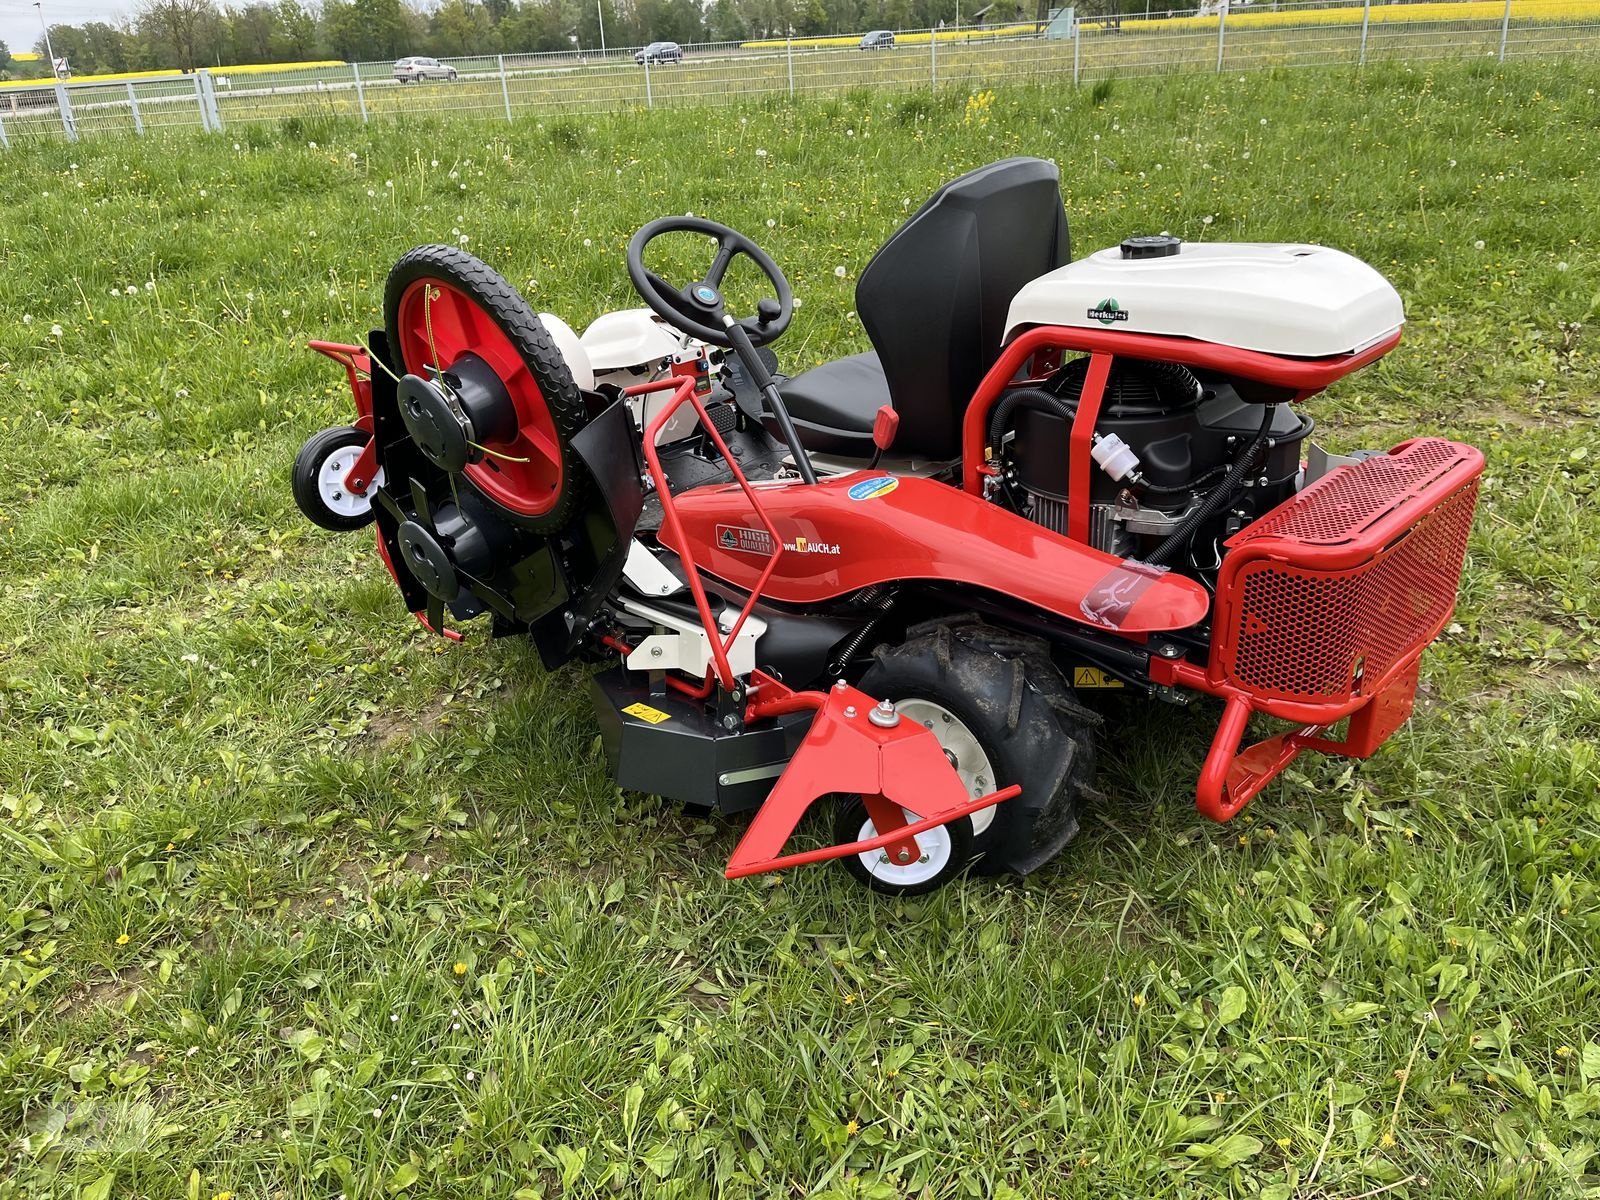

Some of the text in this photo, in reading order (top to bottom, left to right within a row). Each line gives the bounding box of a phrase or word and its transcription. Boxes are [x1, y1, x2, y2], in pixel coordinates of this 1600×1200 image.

[738, 529, 770, 543] HIGH
[740, 539, 771, 553] QUALITY
[782, 540, 841, 555] ww.MAUCH.at
